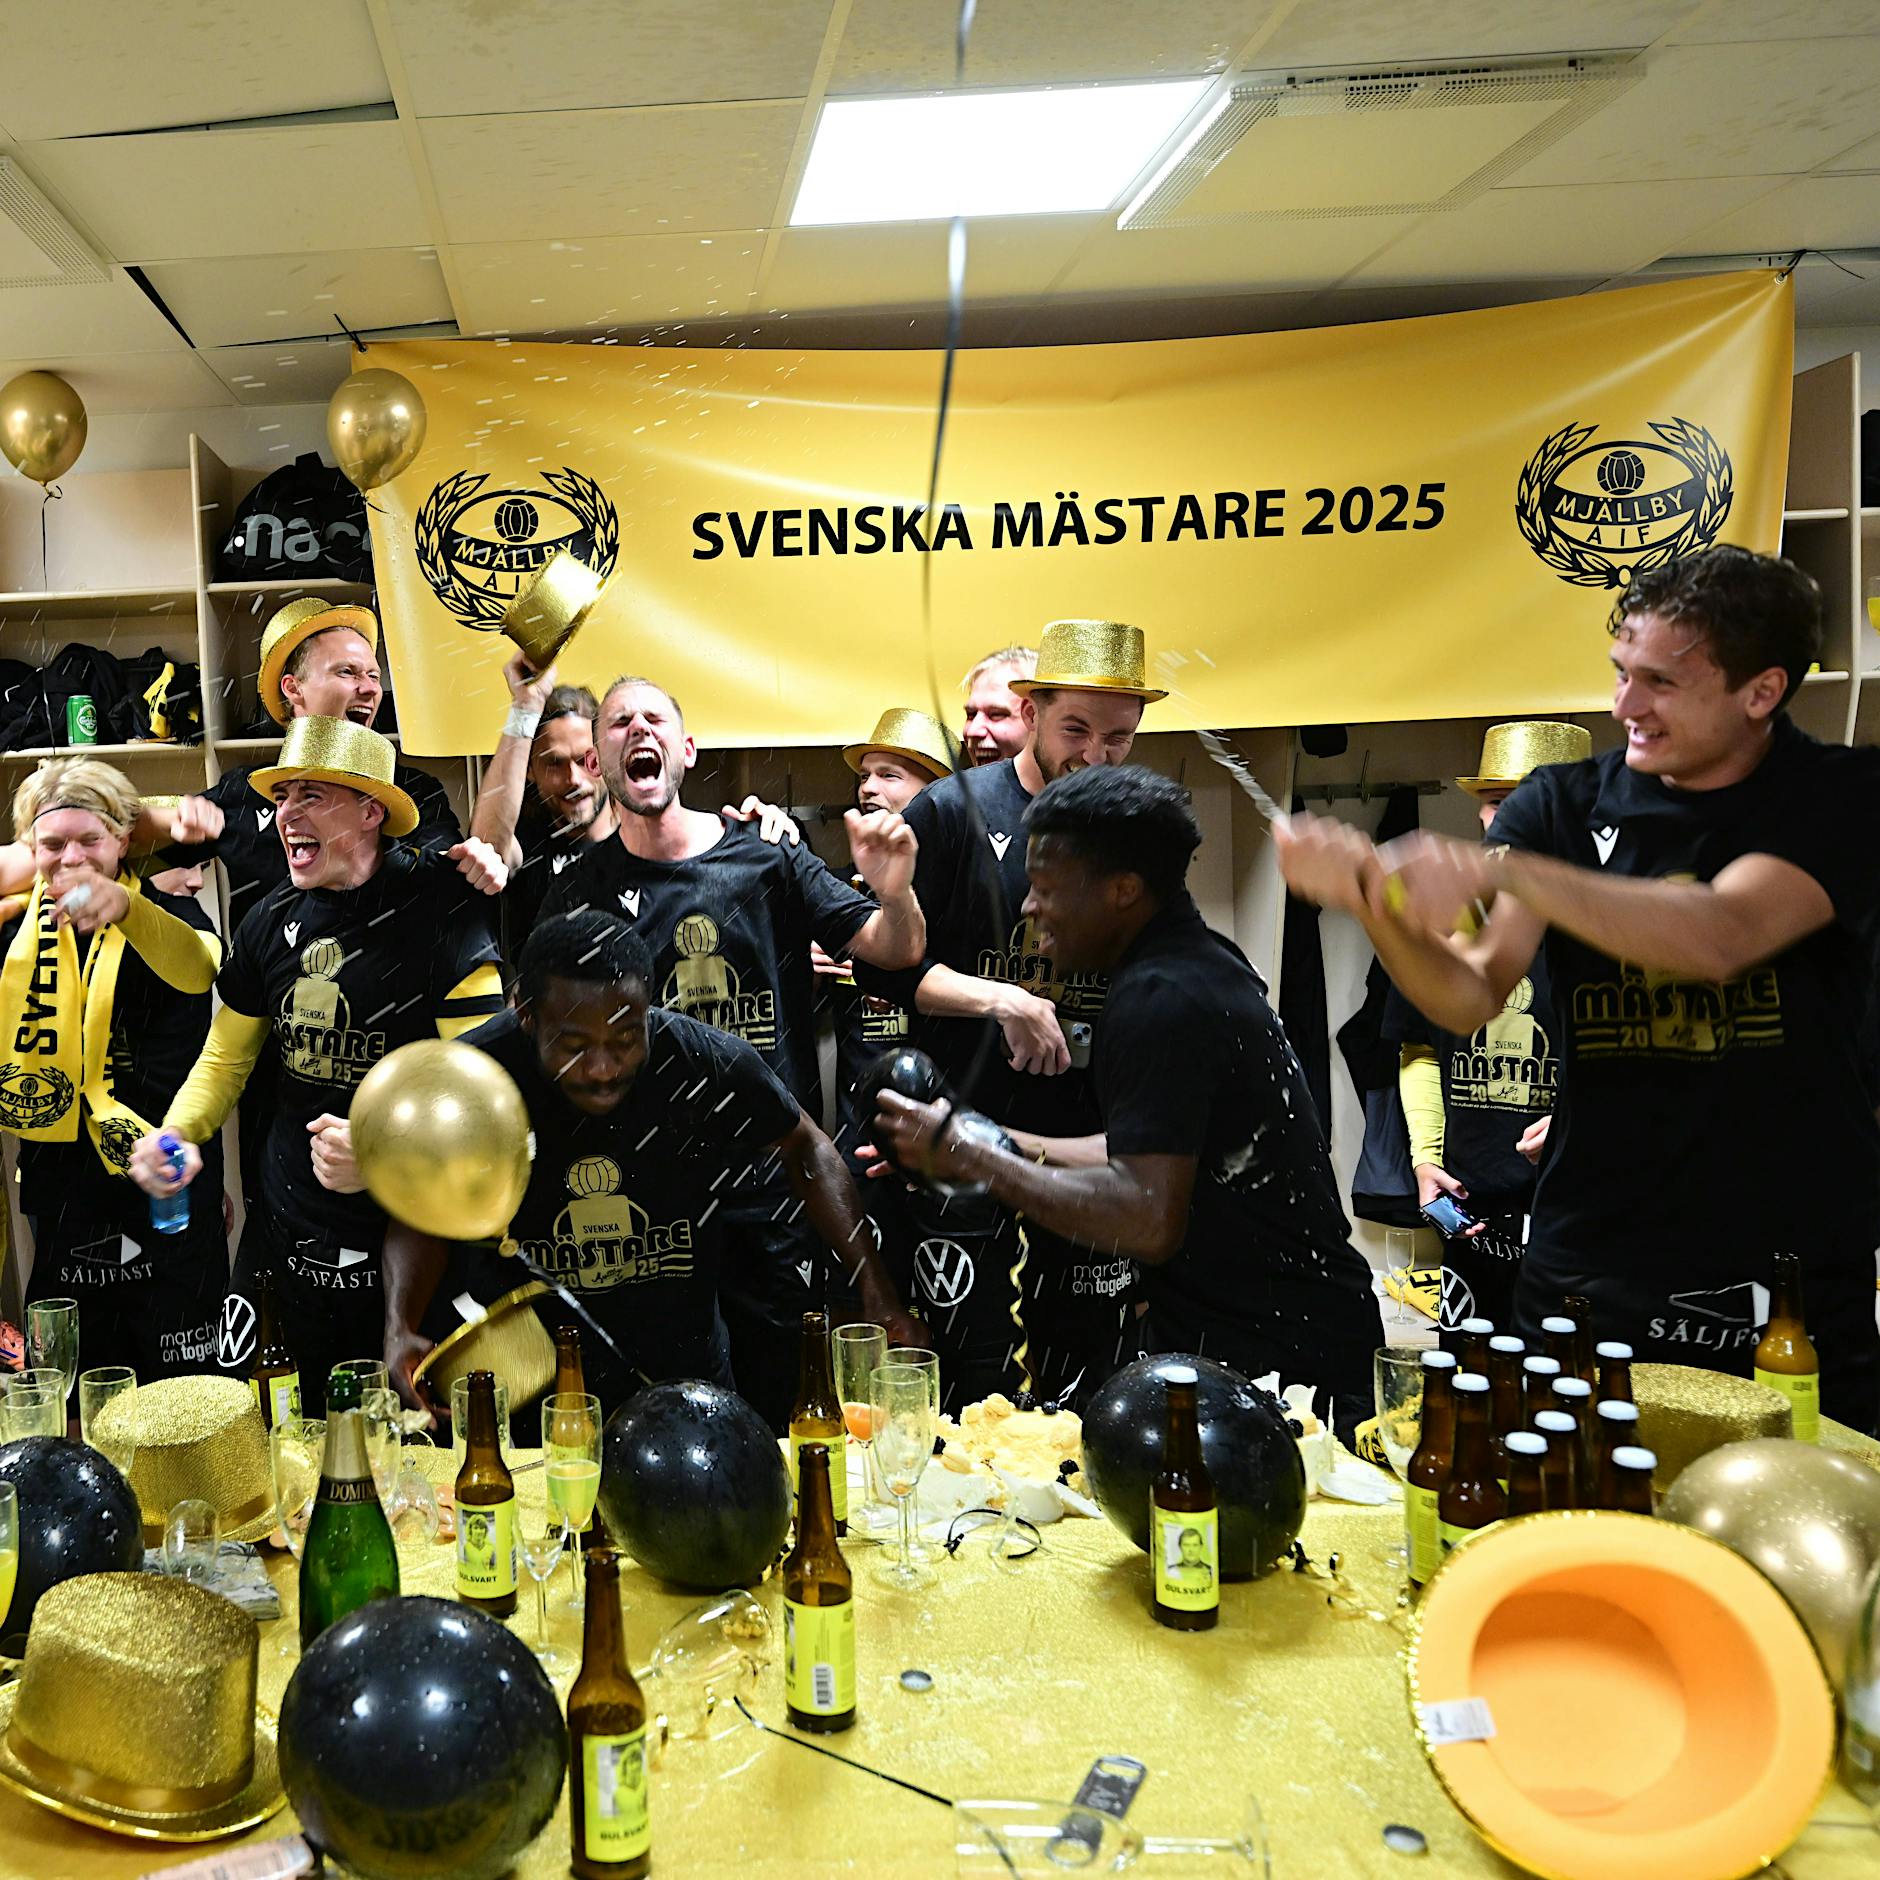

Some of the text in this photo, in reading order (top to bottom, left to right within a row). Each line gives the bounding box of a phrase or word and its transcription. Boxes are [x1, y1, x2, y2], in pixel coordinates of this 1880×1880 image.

[1555, 488, 1683, 523] MJÄLLBY
[692, 482, 1447, 560] SVENSKA MÄSTARE 2025
[1586, 525, 1650, 547] AIF
[882, 1019, 898, 1035] 20
[333, 1062, 351, 1083] 25
[1469, 1084, 1487, 1102] 20
[583, 1223, 620, 1234] SVENSKA
[521, 1219, 692, 1272] MÄSTARE
[60, 1263, 153, 1287] SÄLJFAST
[638, 1258, 659, 1276] 25
[1072, 1281, 1094, 1296] on
[162, 1349, 180, 1362] on
